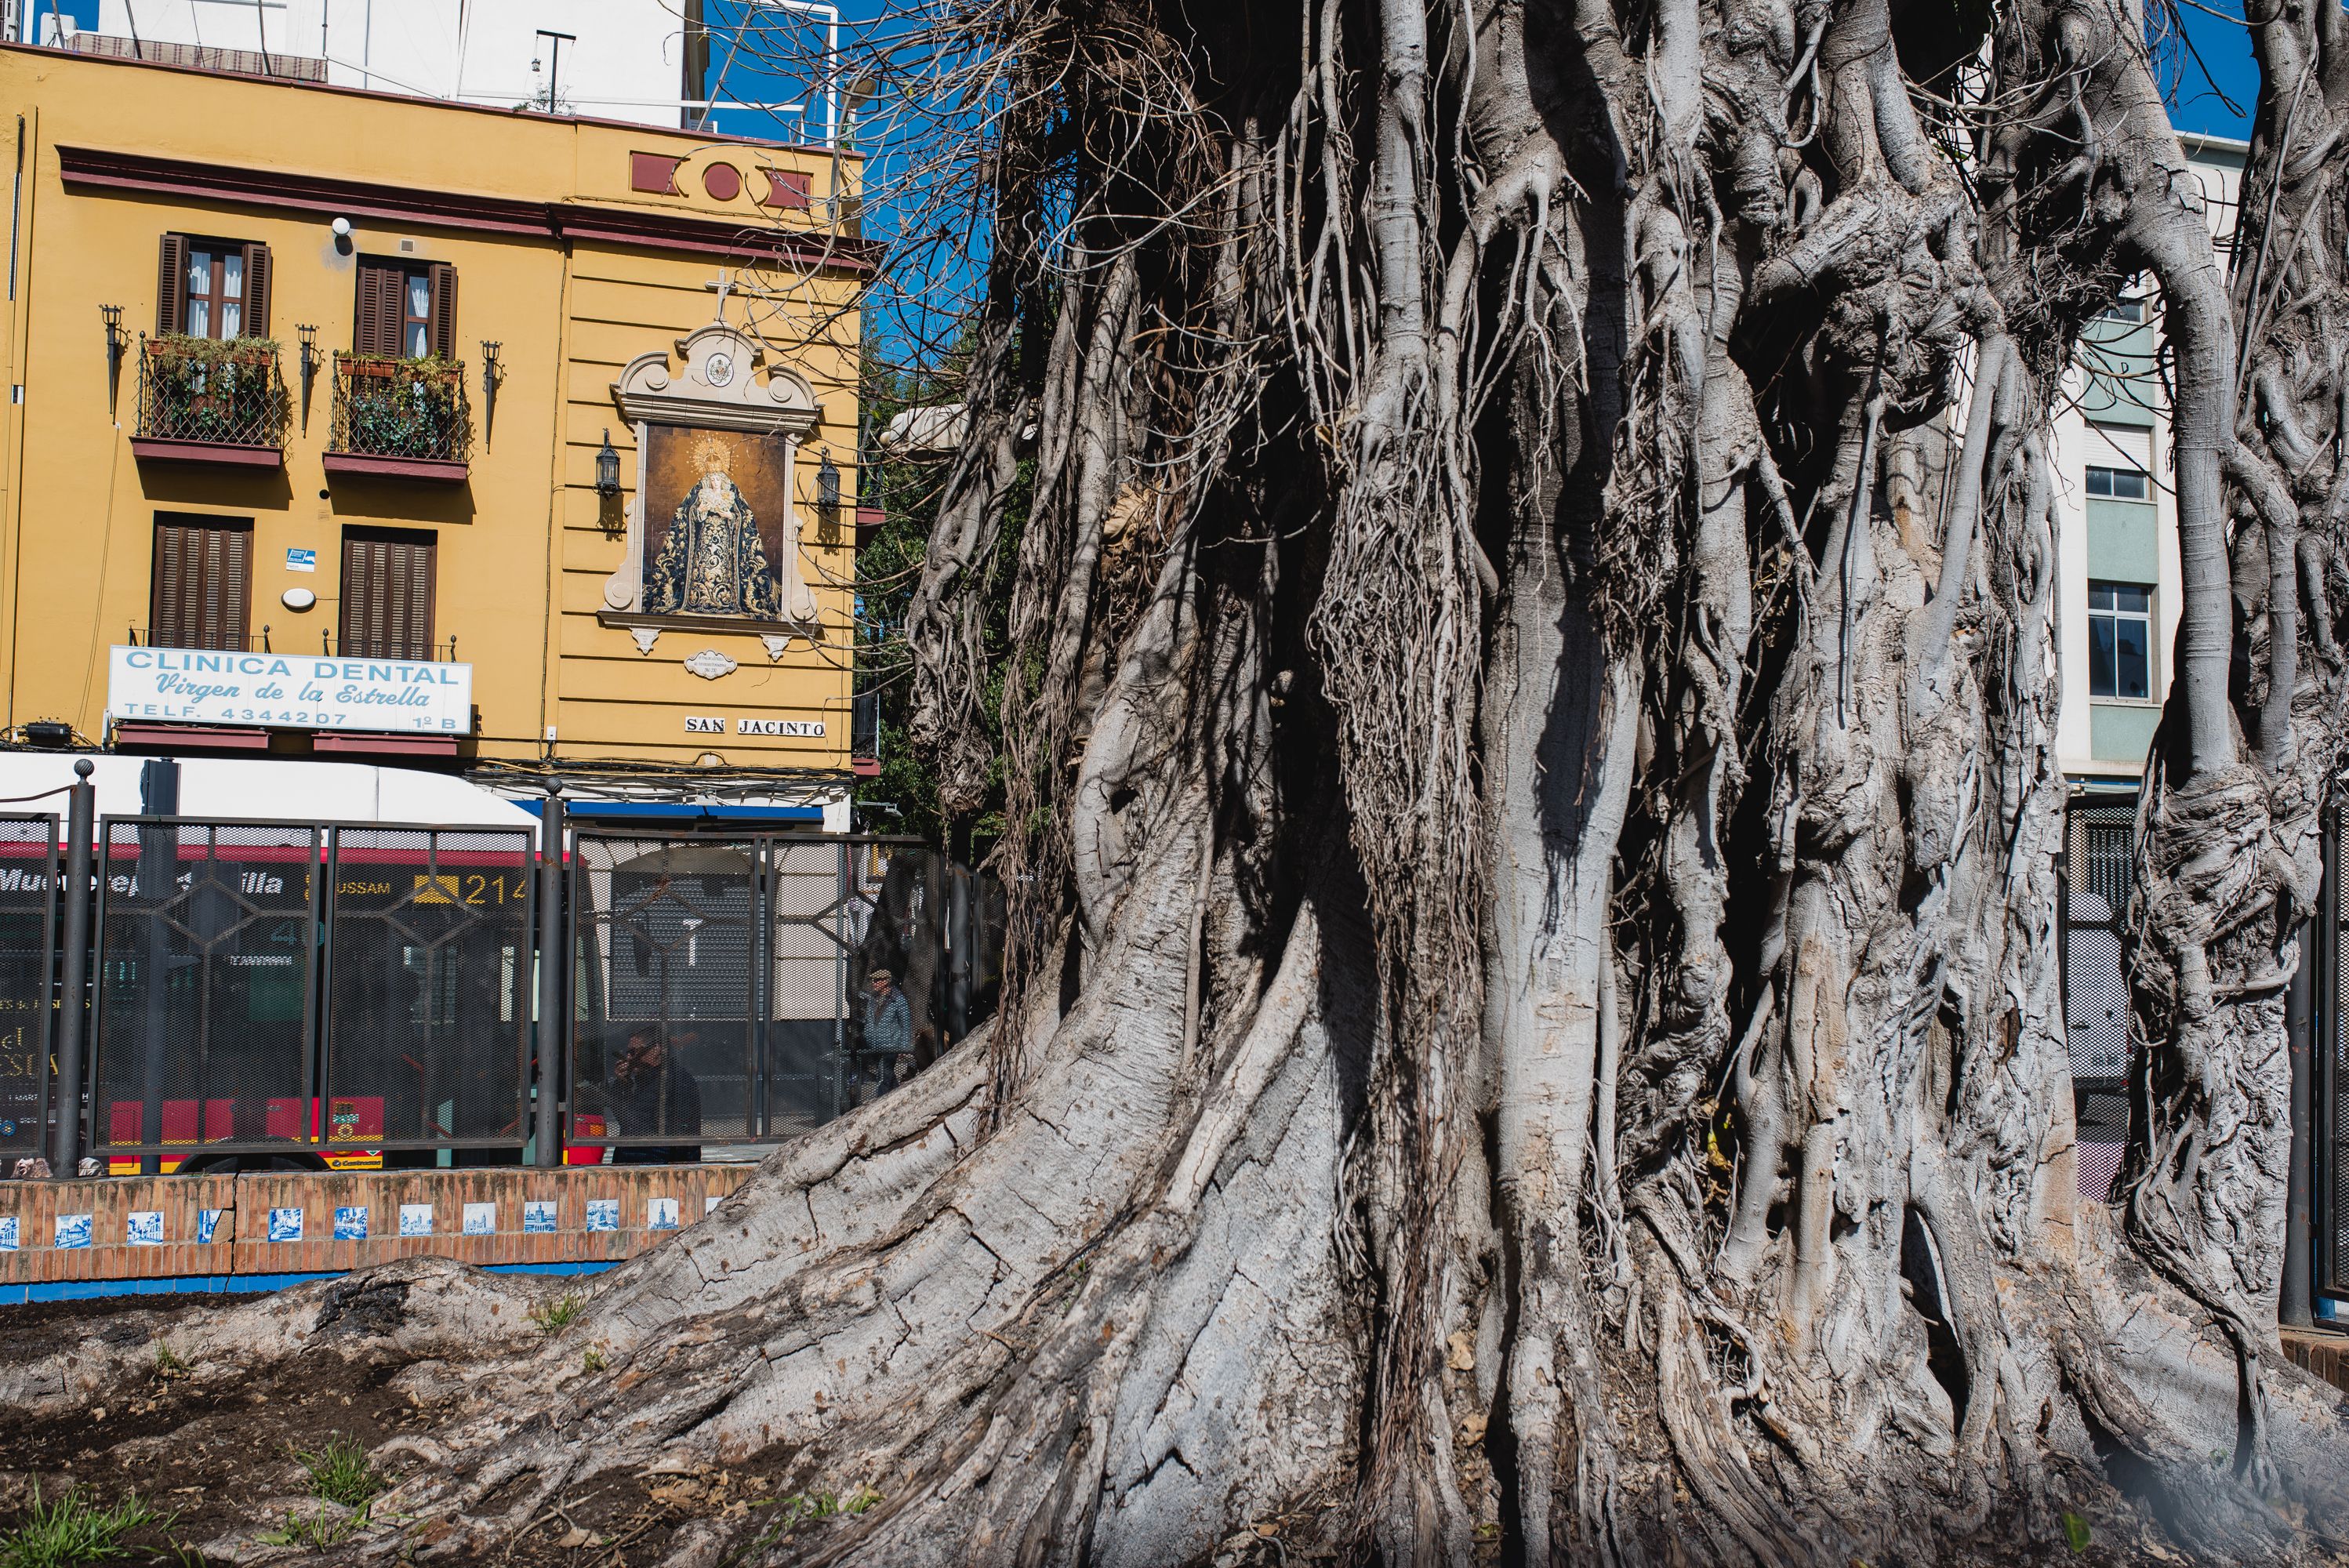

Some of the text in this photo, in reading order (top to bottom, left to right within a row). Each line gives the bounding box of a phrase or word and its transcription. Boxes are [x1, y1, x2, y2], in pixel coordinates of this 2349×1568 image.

[126, 652, 459, 685] CLINICA DENTAL
[155, 672, 430, 706] Virgen de la Estrella
[125, 702, 201, 717] TELF.
[220, 708, 347, 725] 4344207
[441, 718, 456, 729] B
[686, 718, 825, 736] SAN JACINTO
[336, 881, 390, 895] USSAM
